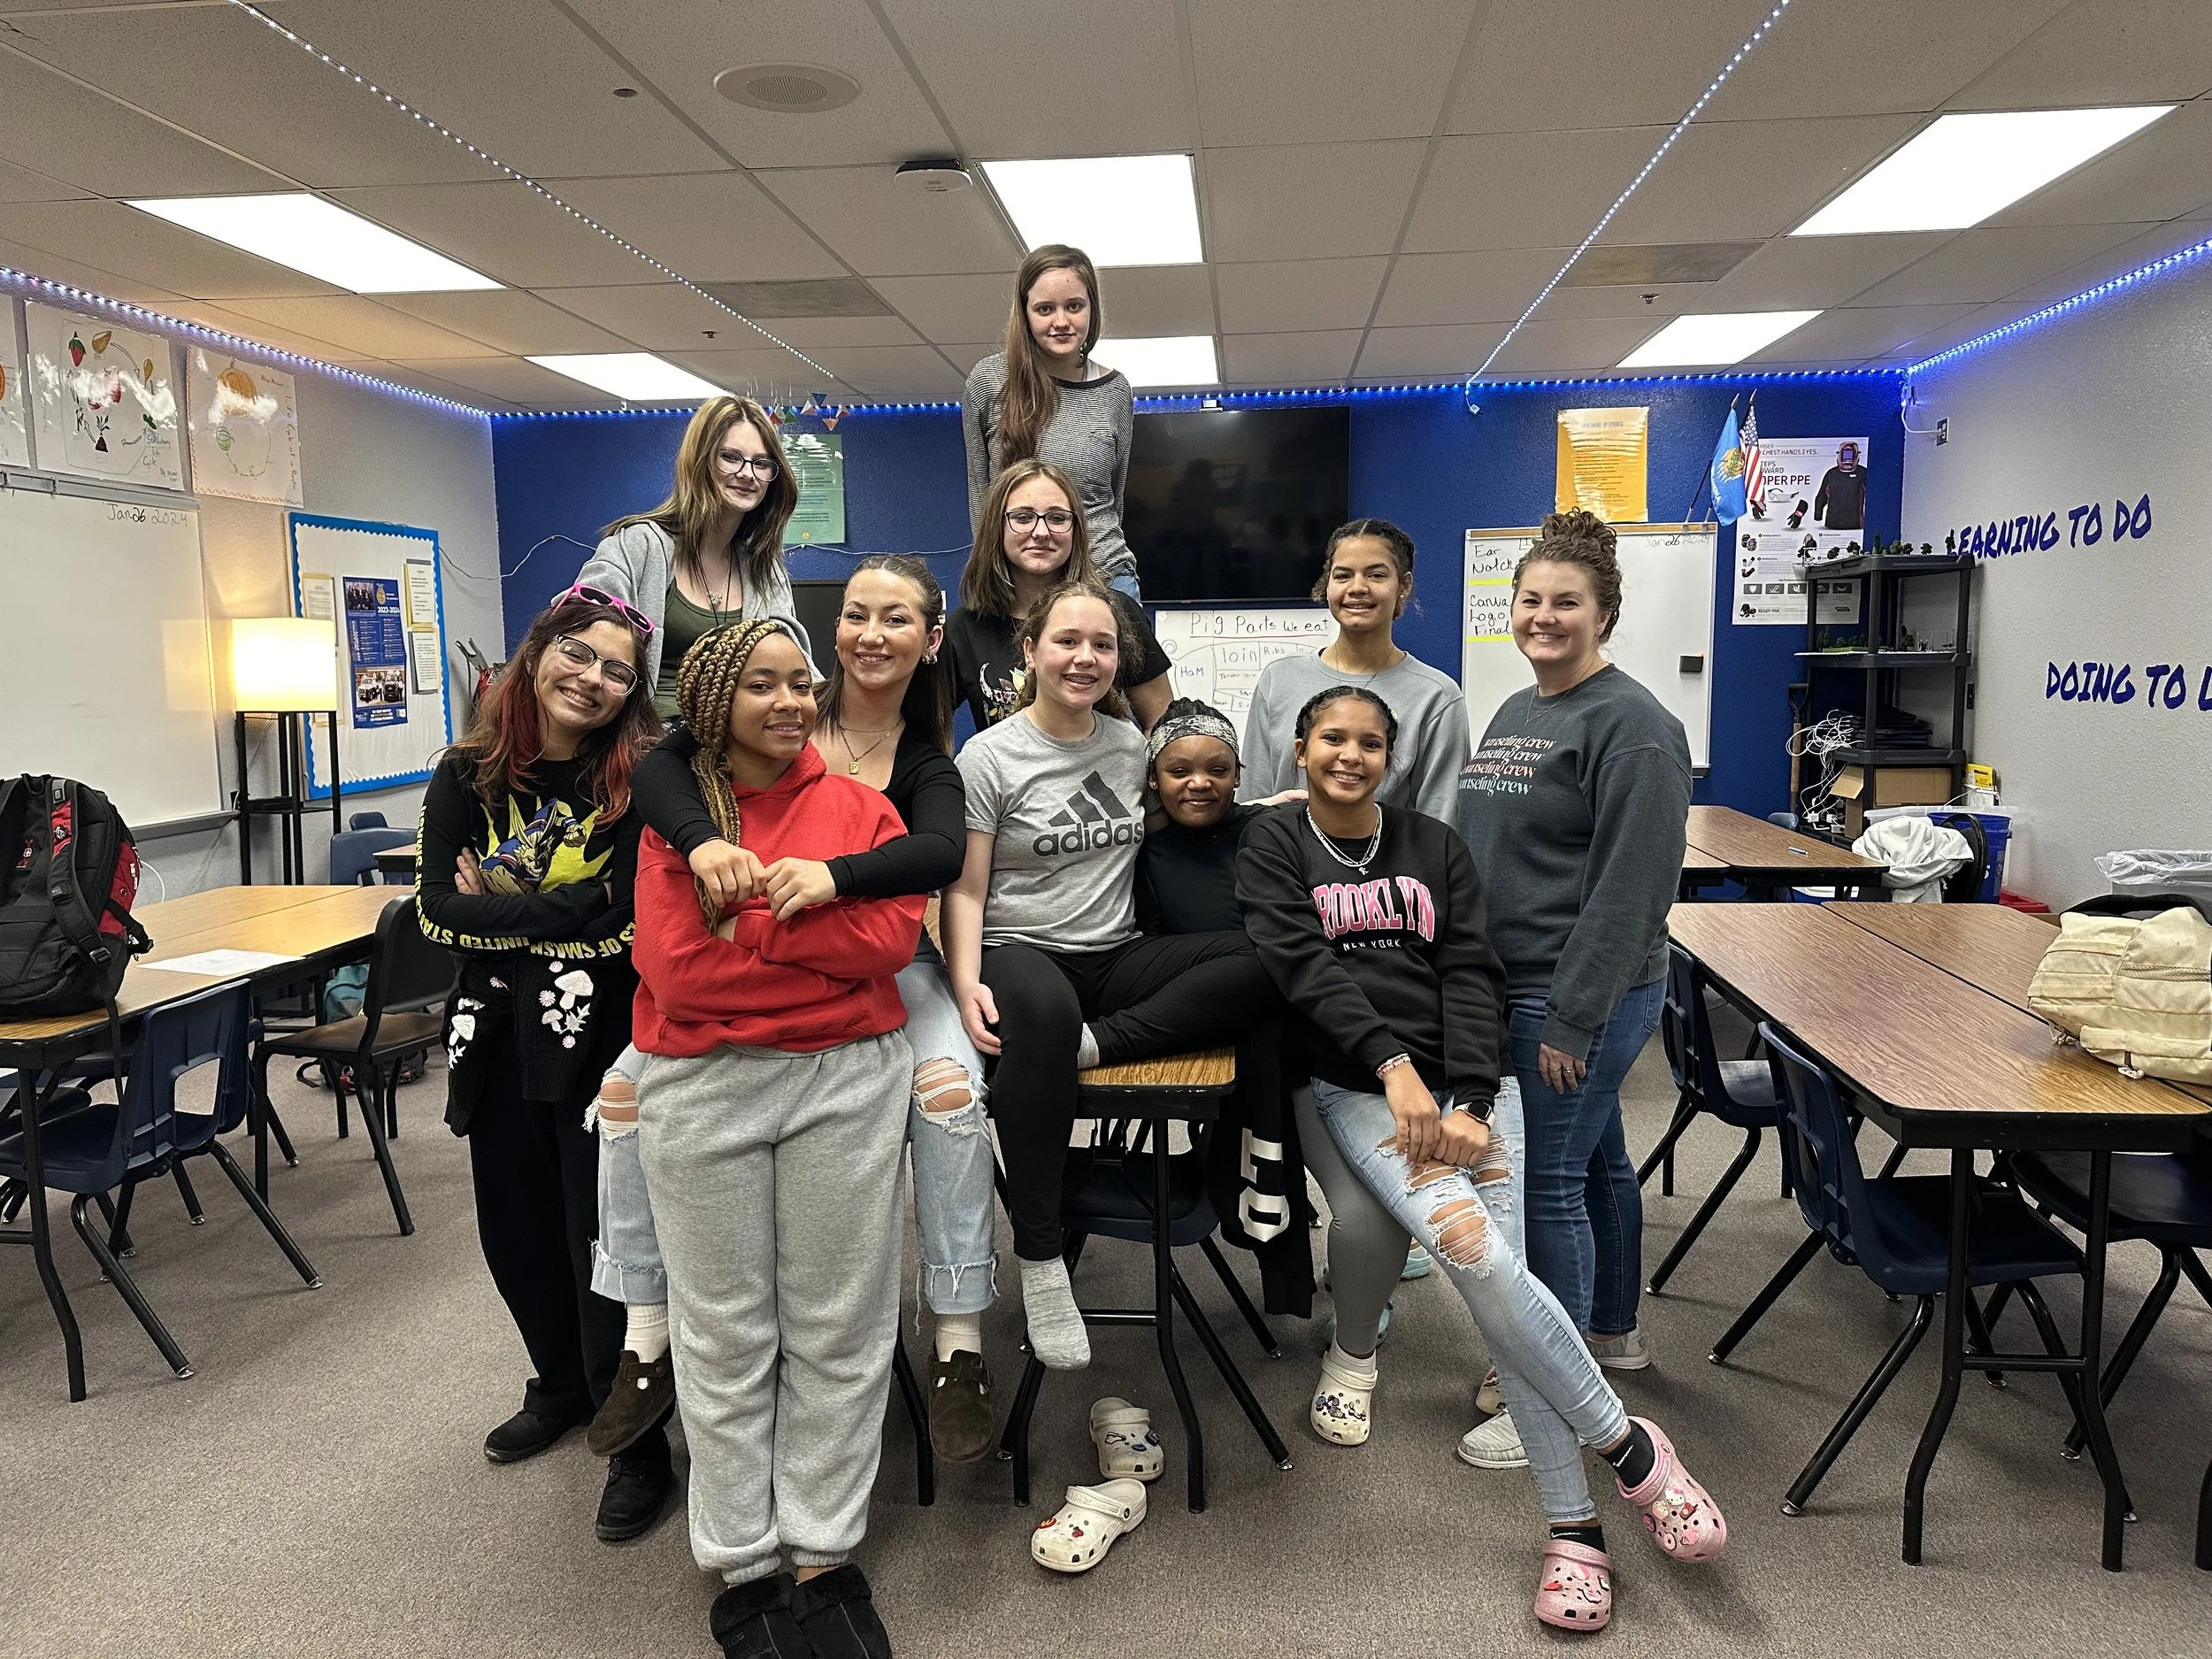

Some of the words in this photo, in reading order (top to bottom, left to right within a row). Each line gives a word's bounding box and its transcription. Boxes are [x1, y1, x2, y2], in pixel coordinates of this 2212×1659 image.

[1763, 475, 1788, 485] OPER
[1790, 474, 1810, 485] PPE
[150, 509, 188, 527] 2024
[2068, 503, 2102, 549] TO
[2113, 493, 2152, 542] DO
[1474, 544, 1502, 557] Ear
[1470, 594, 1511, 608] Canva
[1190, 612, 1224, 634] Pig
[1236, 615, 1277, 634] Parts
[1283, 620, 1298, 632] We
[1304, 616, 1328, 632] eat
[1470, 609, 1506, 626] Logo
[1474, 620, 1512, 636] Final
[2046, 661, 2136, 704] DOING
[2146, 664, 2186, 709] TO
[1525, 736, 1556, 750] crew
[1514, 750, 1546, 762] crew
[1503, 764, 1536, 779] crew
[1496, 779, 1532, 795] crew
[1033, 818, 1144, 856] adidas
[1310, 876, 1435, 942] ROOKLYN
[460, 934, 530, 950] UNITED
[530, 941, 596, 959] SMASH
[598, 938, 622, 957] OF
[1342, 942, 1366, 951] NEW
[1371, 939, 1402, 949] YORK
